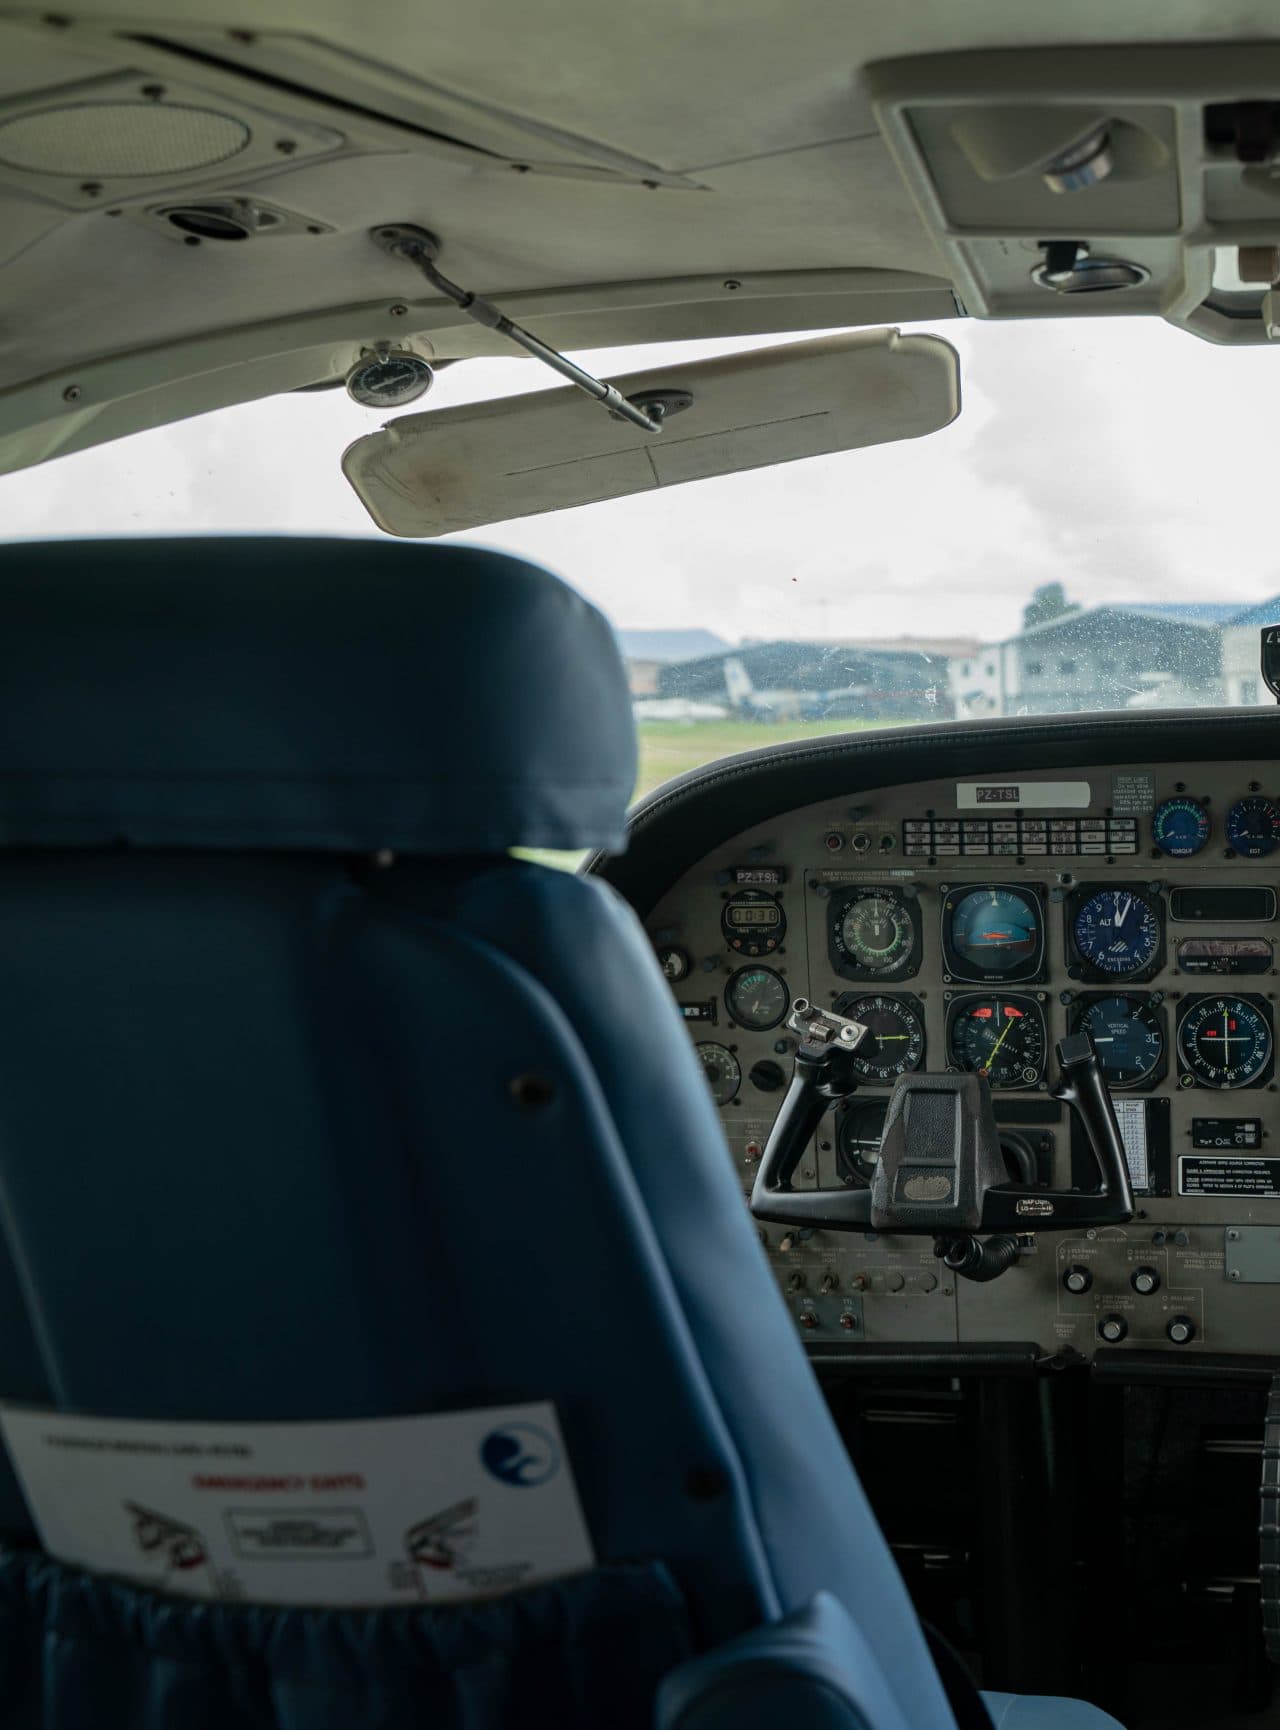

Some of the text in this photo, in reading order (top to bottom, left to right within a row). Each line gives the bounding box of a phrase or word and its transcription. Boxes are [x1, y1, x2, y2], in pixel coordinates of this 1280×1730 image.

[977, 789, 1020, 801] PZ-TSL
[736, 872, 778, 883] PZ-TSL
[1099, 919, 1112, 927] ALT
[1145, 1034, 1152, 1043] 3
